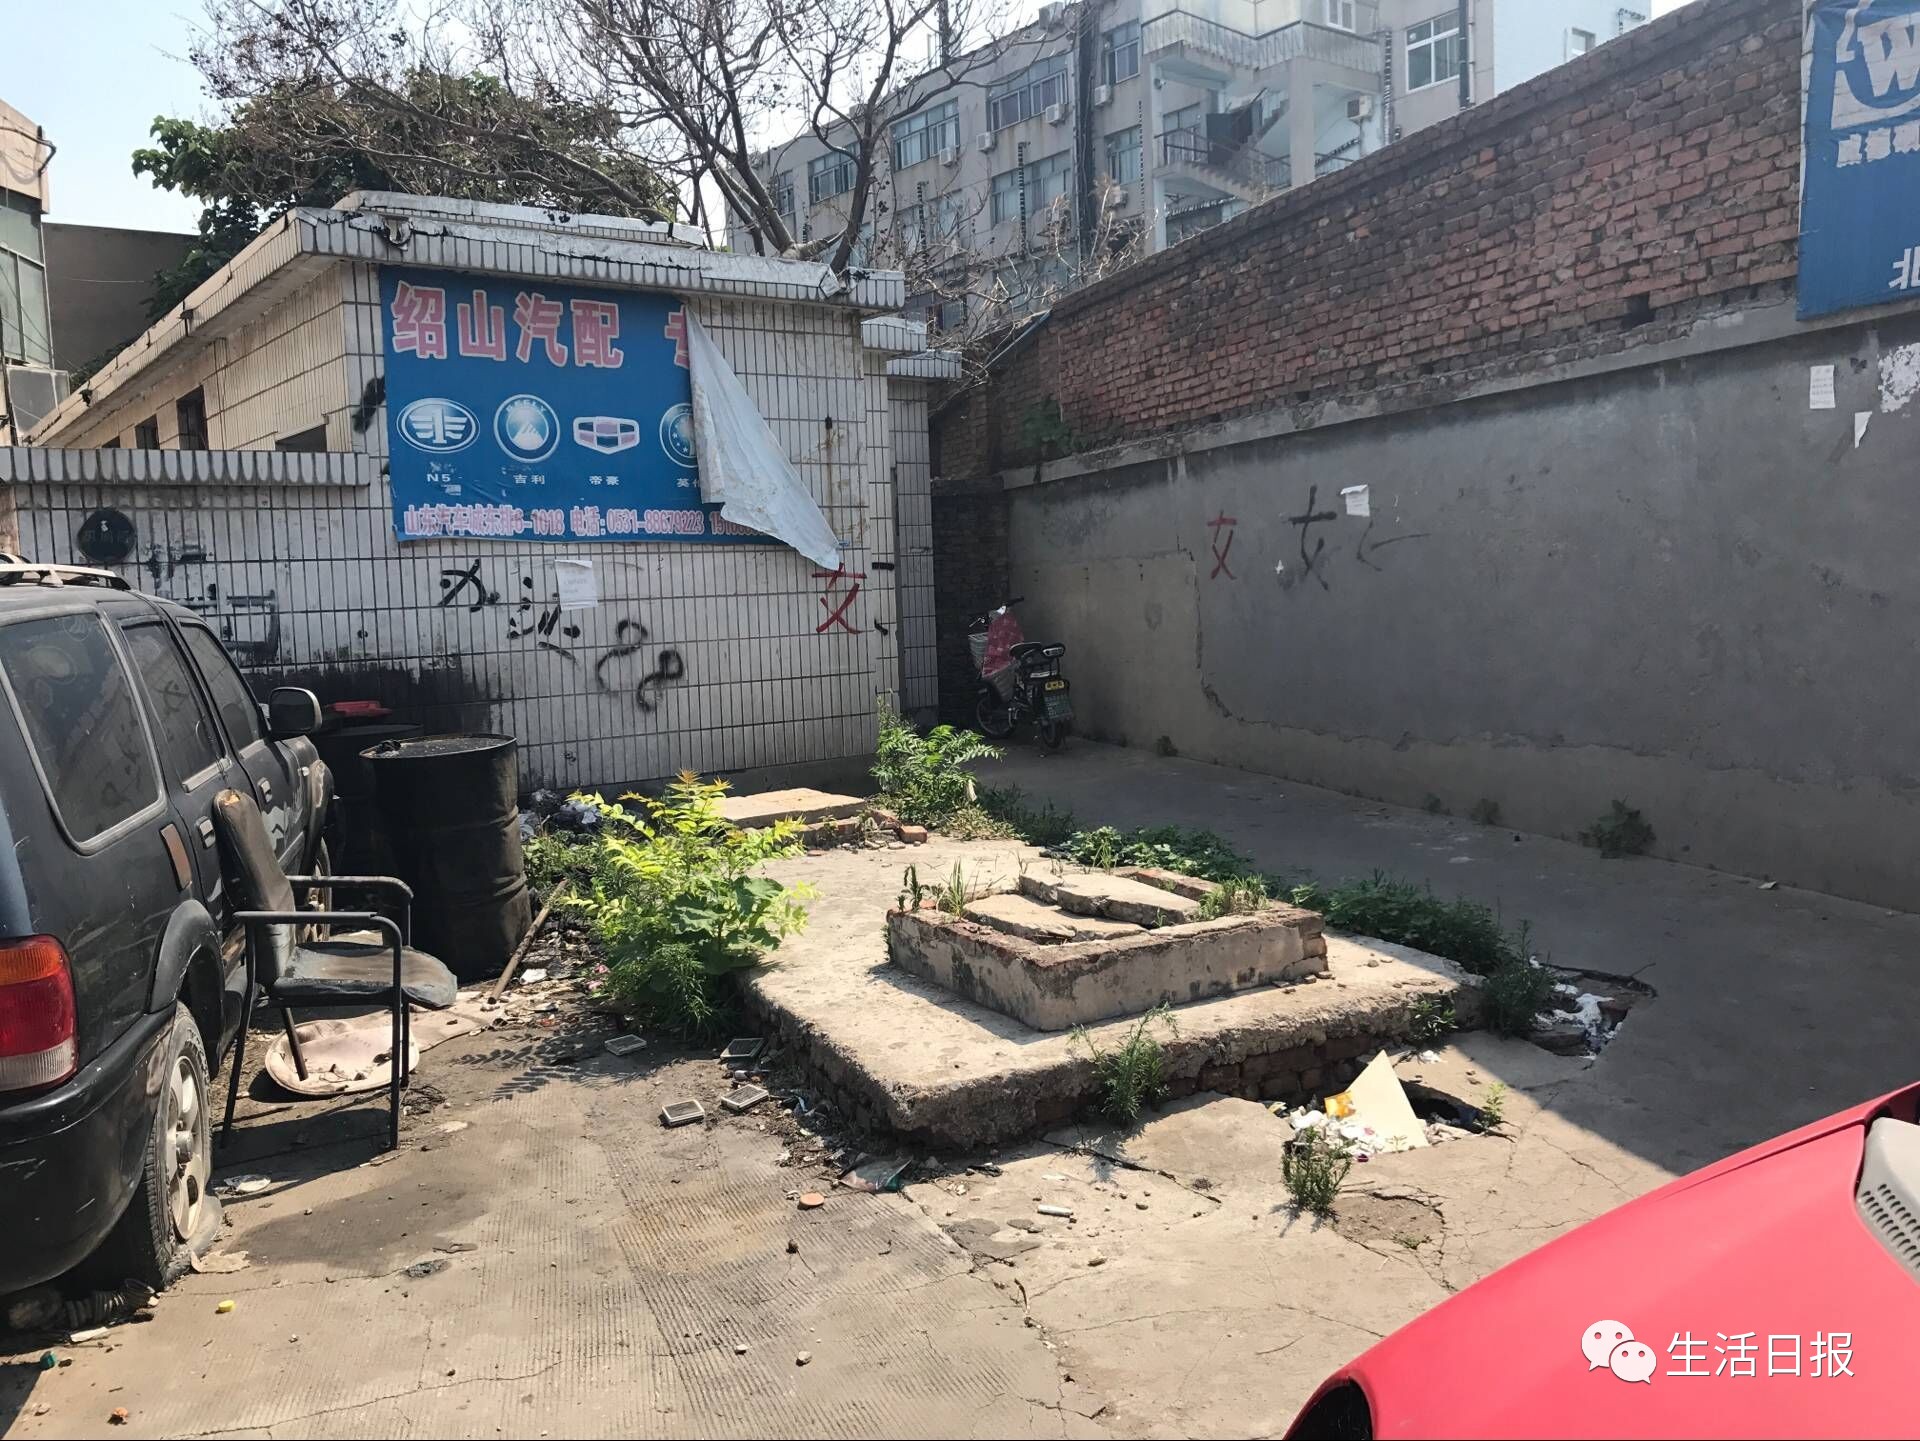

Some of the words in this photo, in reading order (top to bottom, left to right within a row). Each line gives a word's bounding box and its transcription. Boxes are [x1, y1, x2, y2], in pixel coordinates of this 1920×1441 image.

[391, 281, 624, 368] 绍山汽配
[513, 473, 545, 485] 吉利
[589, 475, 620, 486] 帝豪
